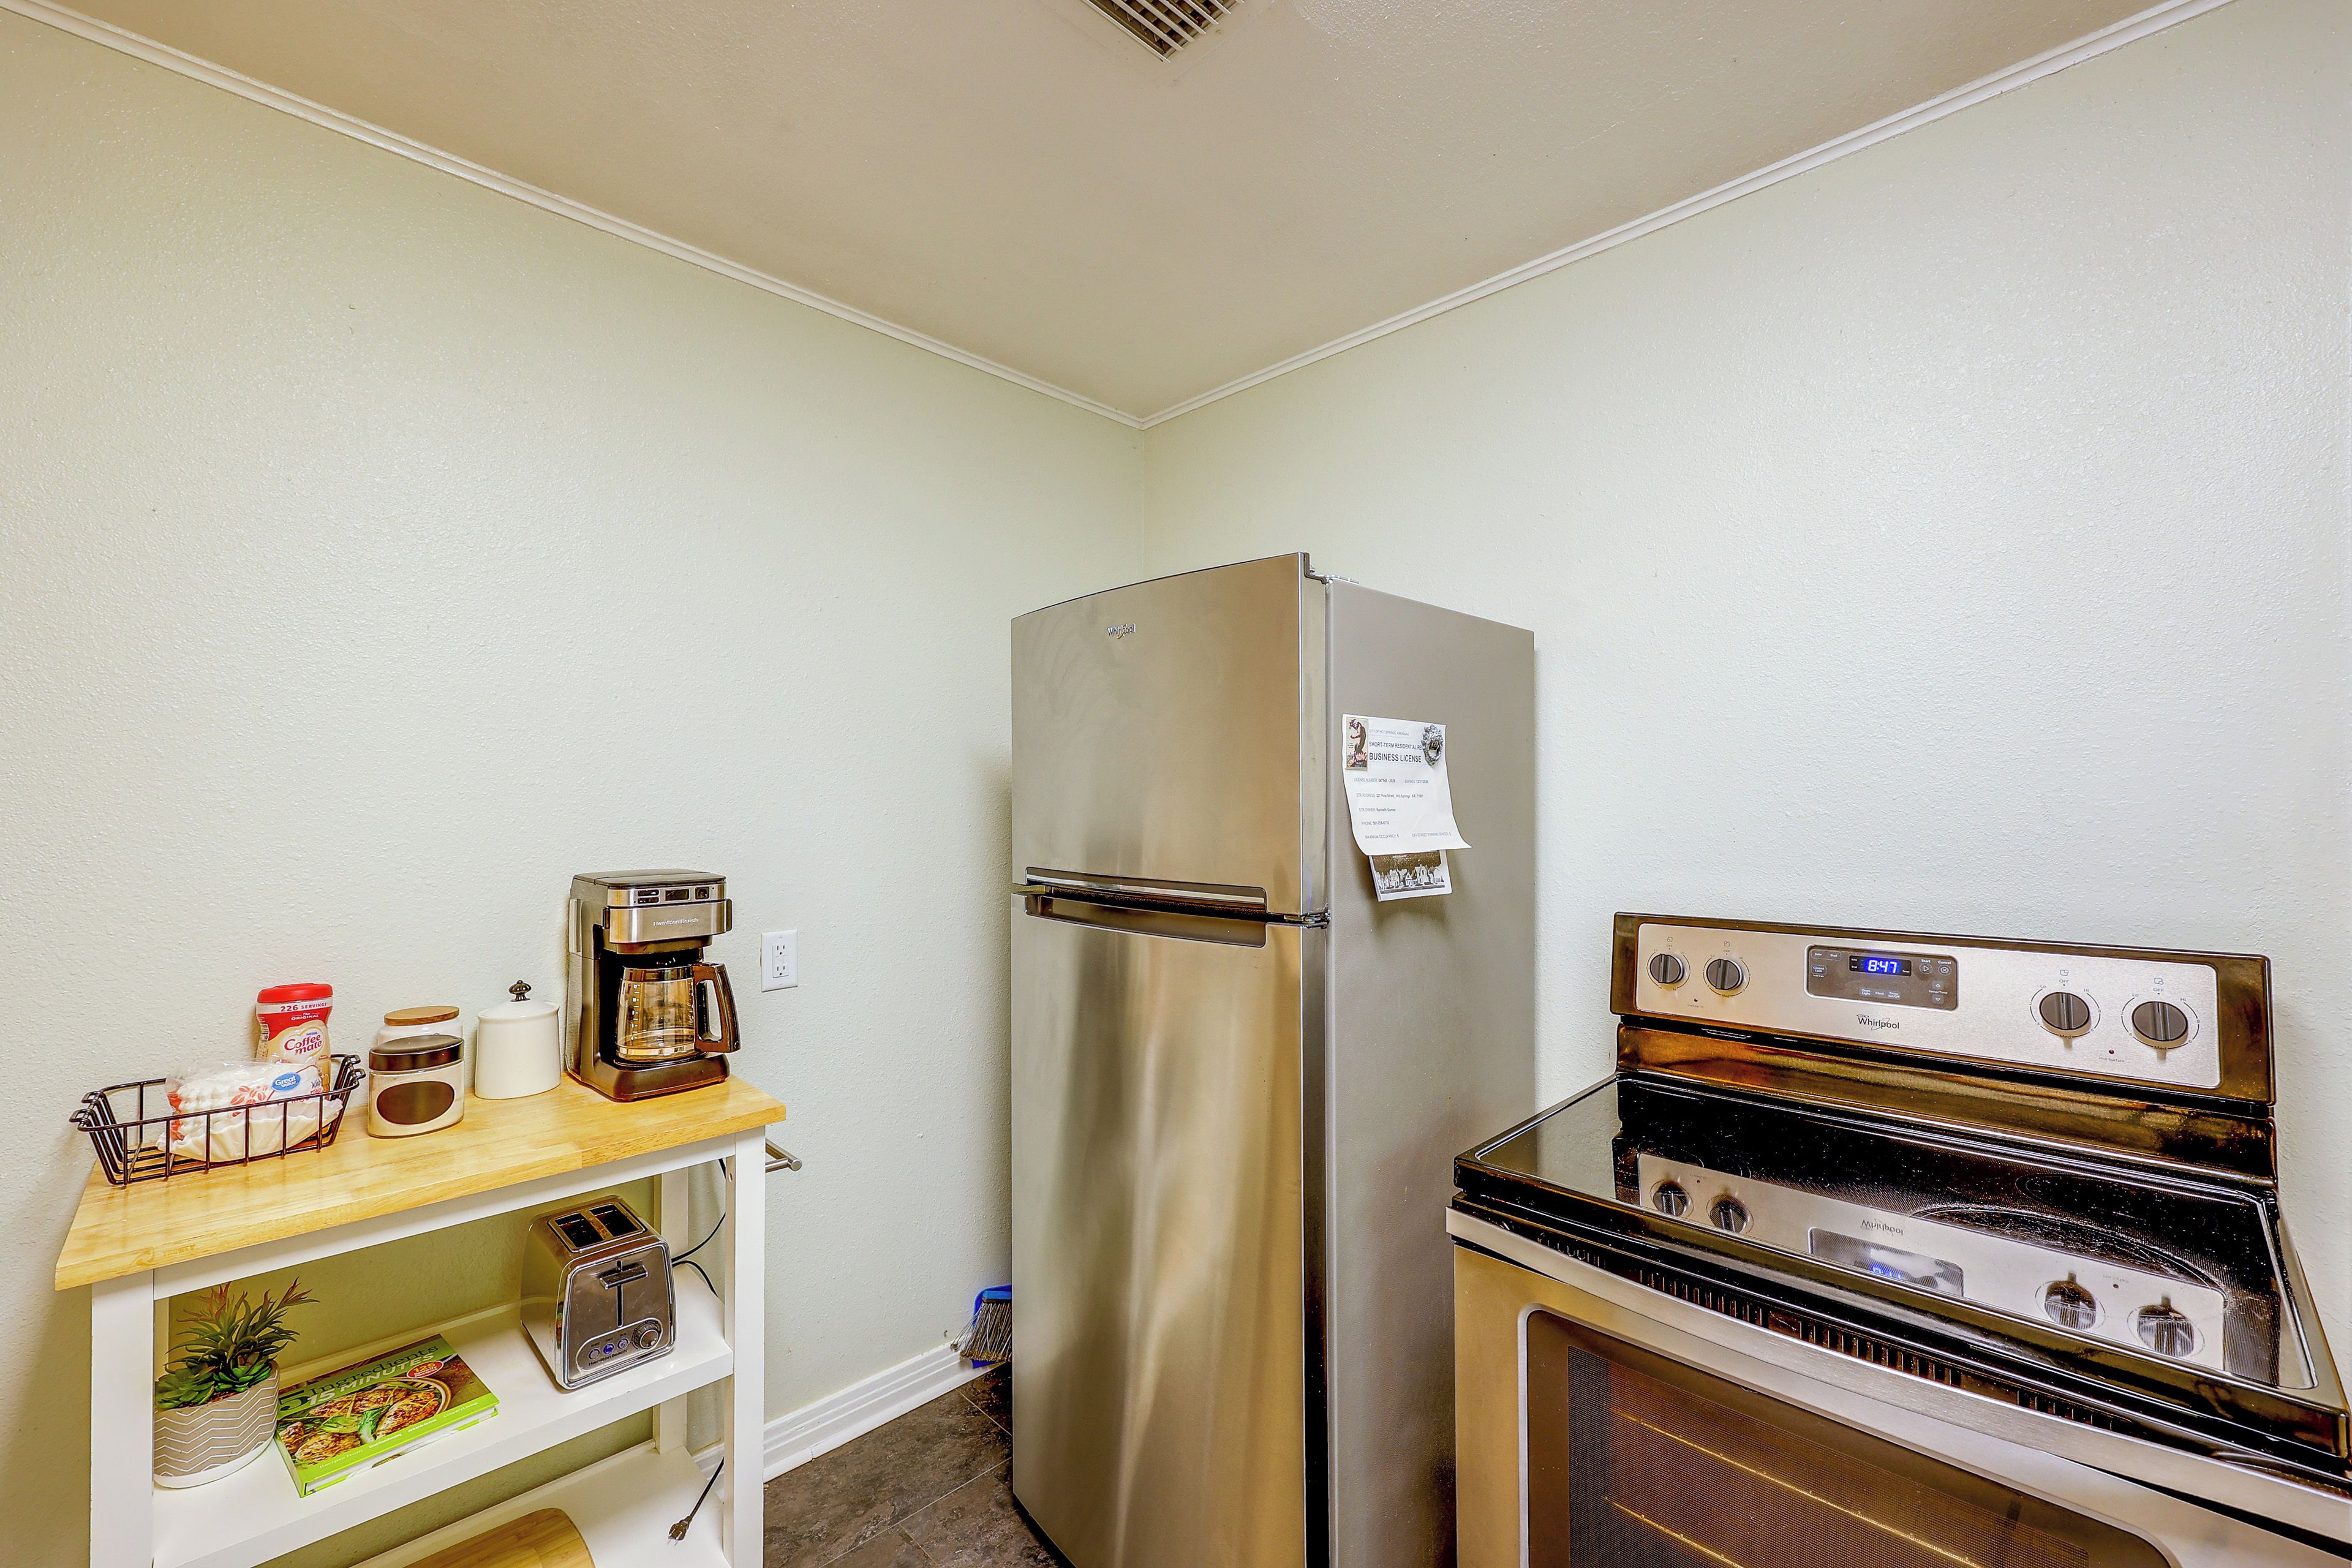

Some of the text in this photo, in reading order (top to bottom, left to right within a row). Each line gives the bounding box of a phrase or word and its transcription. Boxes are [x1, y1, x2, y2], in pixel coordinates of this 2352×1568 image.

[1107, 623, 1136, 639] Whirlpool
[1355, 752, 1367, 761] KONG
[1369, 752, 1422, 763] BUSINESS LICENSE
[1868, 960, 1898, 973] 8:47
[1858, 1016, 1899, 1030] Whirlpool
[284, 1034, 321, 1050] Coffee
[295, 1040, 322, 1055] mate
[275, 1076, 296, 1086] Great
[589, 1349, 628, 1366] Hamilton Beach
[413, 1362, 436, 1373] 125
[280, 1346, 439, 1411] 5 Ingredients
[307, 1352, 434, 1406] 15 MINUTES
